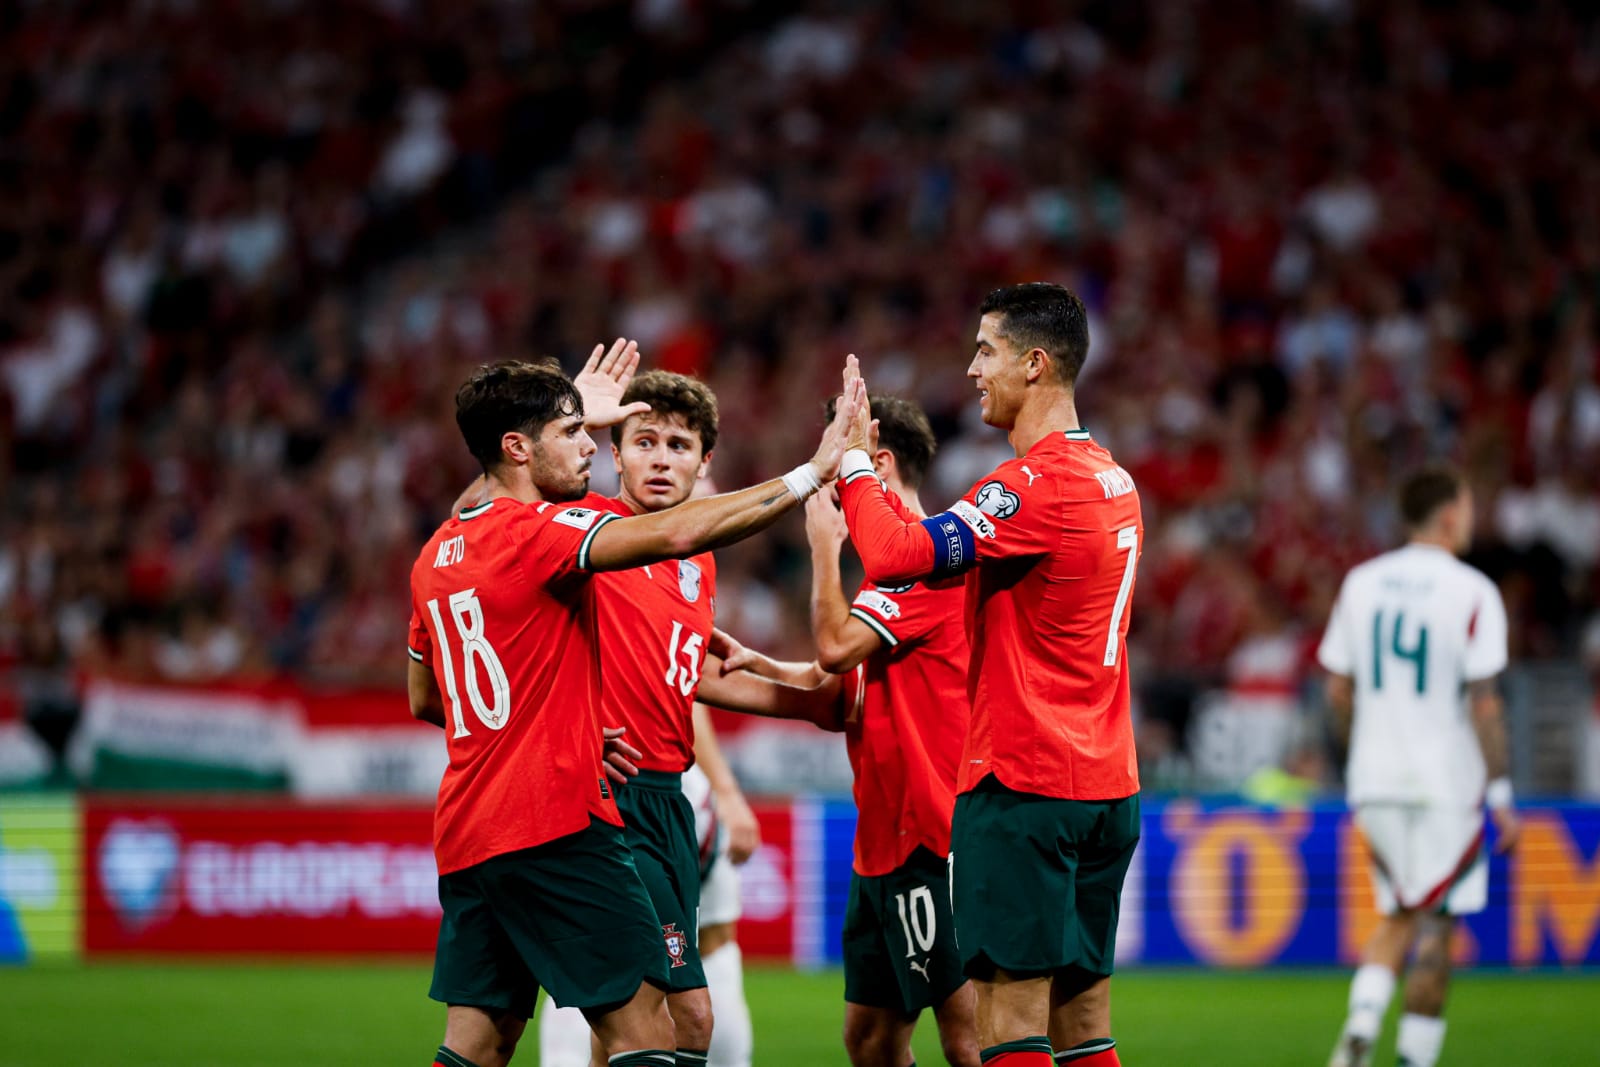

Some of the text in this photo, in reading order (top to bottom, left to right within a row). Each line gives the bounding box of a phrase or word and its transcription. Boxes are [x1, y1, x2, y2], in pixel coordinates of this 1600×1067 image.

[433, 534, 465, 568] NETO
[949, 536, 961, 569] RESPE
[1102, 526, 1138, 667] 7
[427, 587, 511, 739] 18
[665, 619, 704, 697] 15
[1371, 608, 1430, 695] 14
[186, 841, 441, 918] EUROPEA
[894, 885, 937, 958] 10
